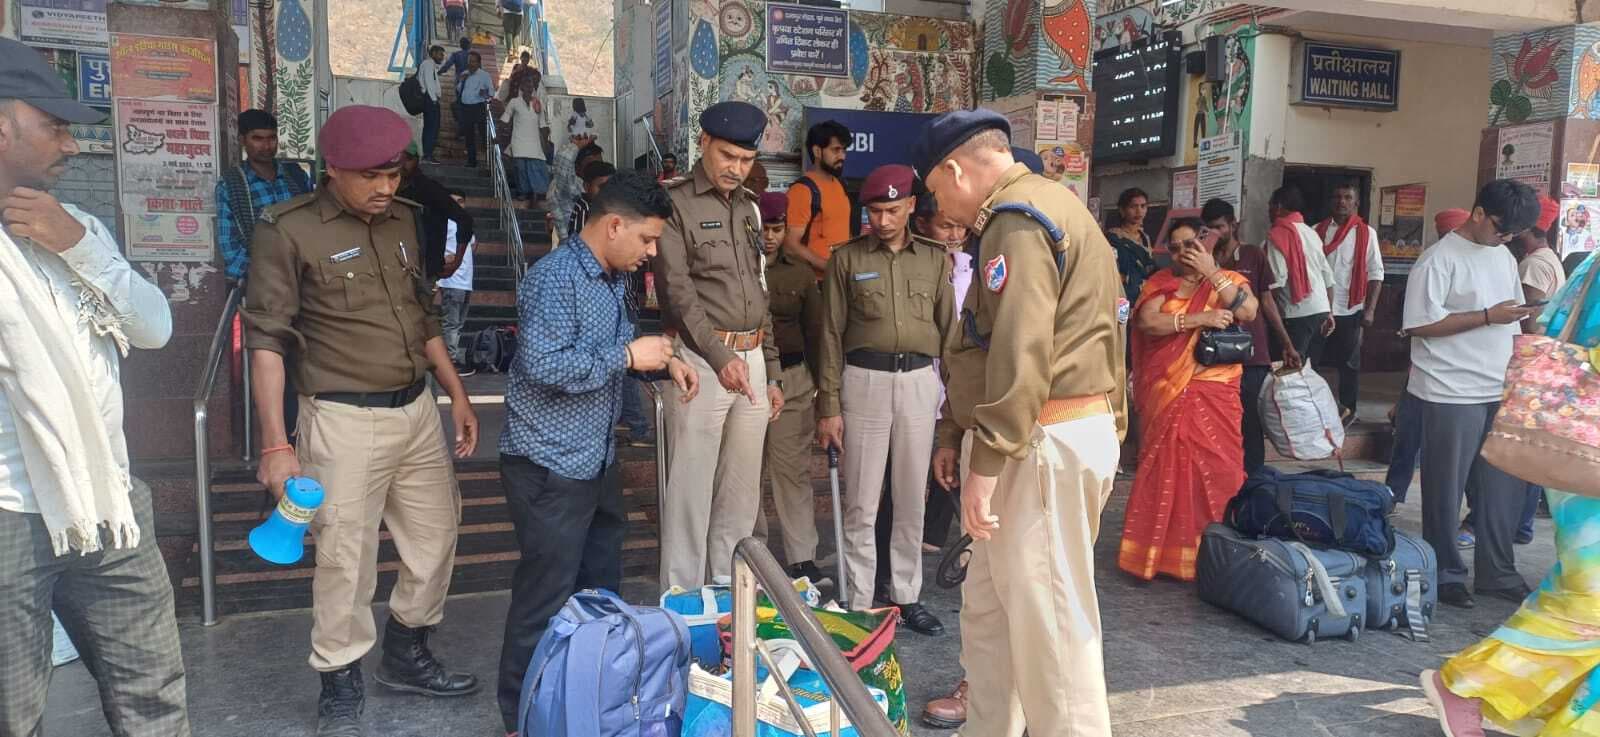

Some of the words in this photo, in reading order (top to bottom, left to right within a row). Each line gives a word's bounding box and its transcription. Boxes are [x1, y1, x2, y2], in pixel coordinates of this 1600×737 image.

[1311, 50, 1392, 75] प्रतीक्षालय
[1311, 78, 1358, 97] WAITING
[1362, 80, 1390, 99] HALL
